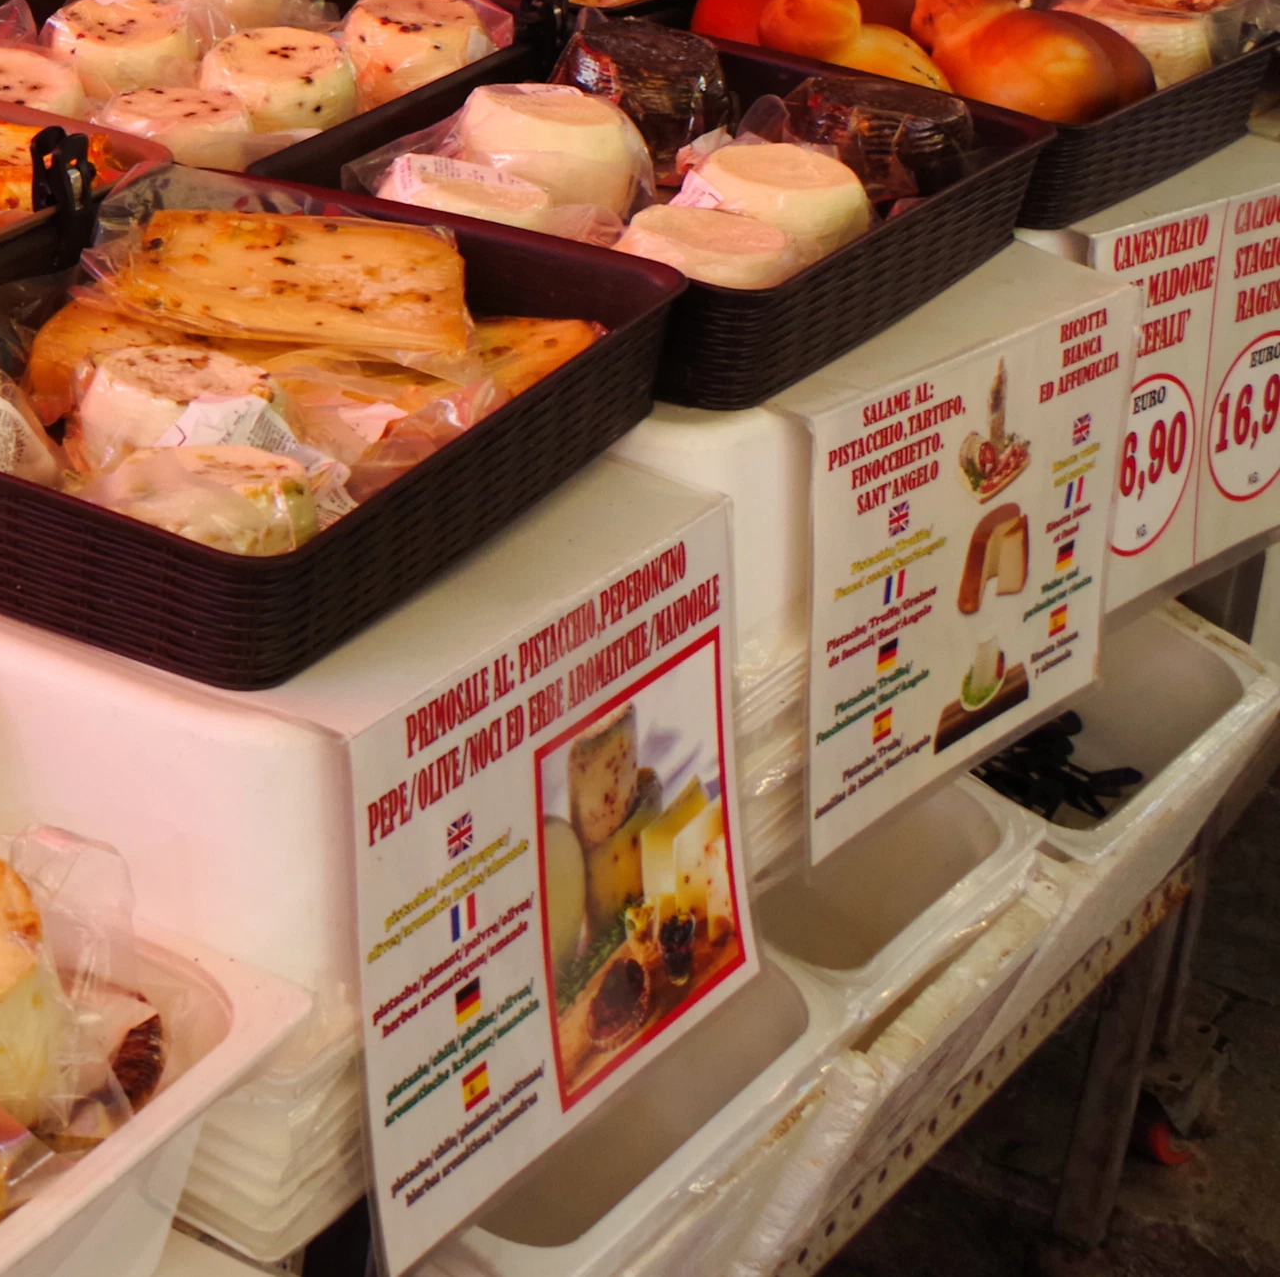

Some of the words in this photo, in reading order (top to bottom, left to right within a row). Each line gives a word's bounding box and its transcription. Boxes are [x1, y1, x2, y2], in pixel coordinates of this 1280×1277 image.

[1113, 212, 1210, 272] CANESTRATO
[1146, 255, 1216, 308] MADONIE
[1060, 308, 1108, 344] RICOTTA
[1062, 335, 1102, 369] BIANCA
[1039, 382, 1054, 405] ED
[1057, 351, 1119, 396] AFFUMICATA
[1132, 385, 1167, 416] EURO
[863, 389, 911, 428] SALAME
[914, 382, 934, 405] AL:
[857, 460, 939, 516] SANT'ANGELO
[406, 667, 489, 758] PRIMOSALE
[494, 653, 515, 702] AL:
[518, 541, 686, 684] PISTACCHIO,PEPERONCINO
[367, 717, 502, 846] PEPE/OLIVE/NOCI
[506, 703, 525, 752] ED
[528, 677, 565, 737] ERBE
[567, 573, 720, 711] AROMATICHE/MANDORLE
[382, 1004, 418, 1038] herbes
